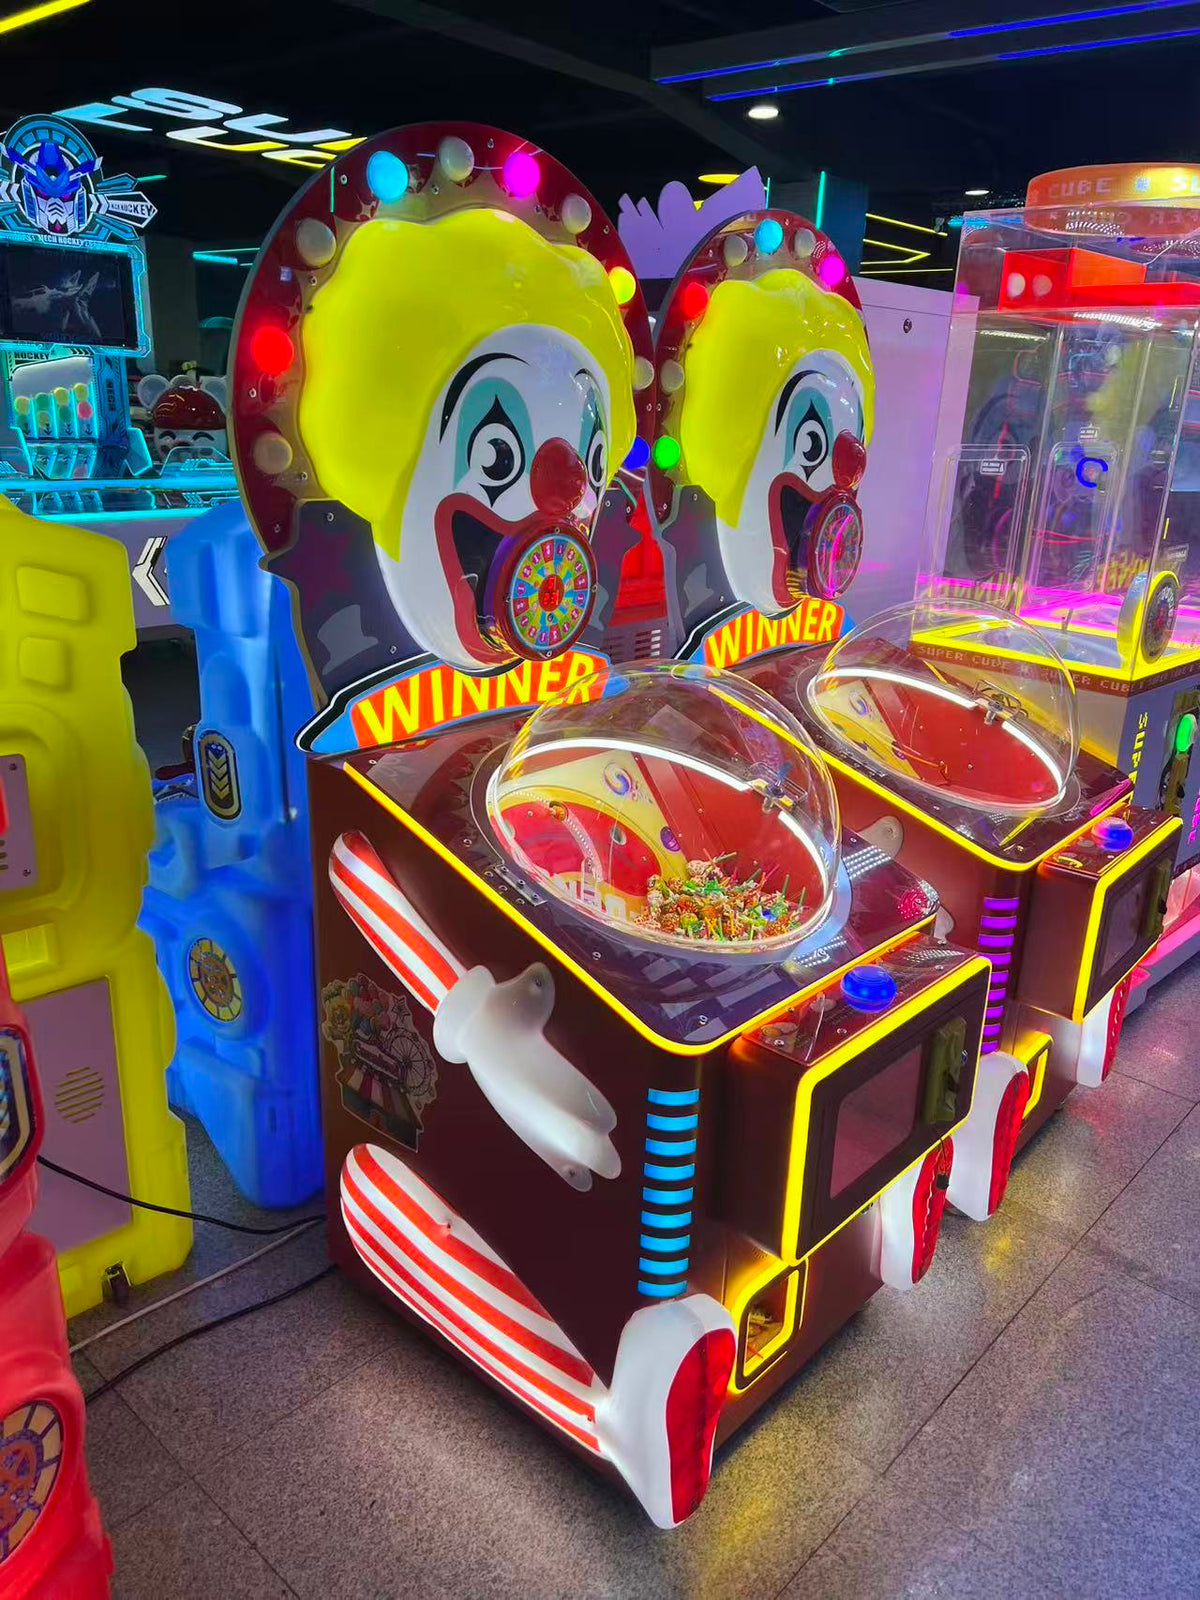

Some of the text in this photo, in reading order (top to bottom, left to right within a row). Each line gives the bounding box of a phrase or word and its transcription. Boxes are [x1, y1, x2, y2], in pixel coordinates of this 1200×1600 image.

[708, 600, 837, 669] WINNER
[918, 645, 963, 662] SUPER
[356, 651, 600, 746] WINNER
